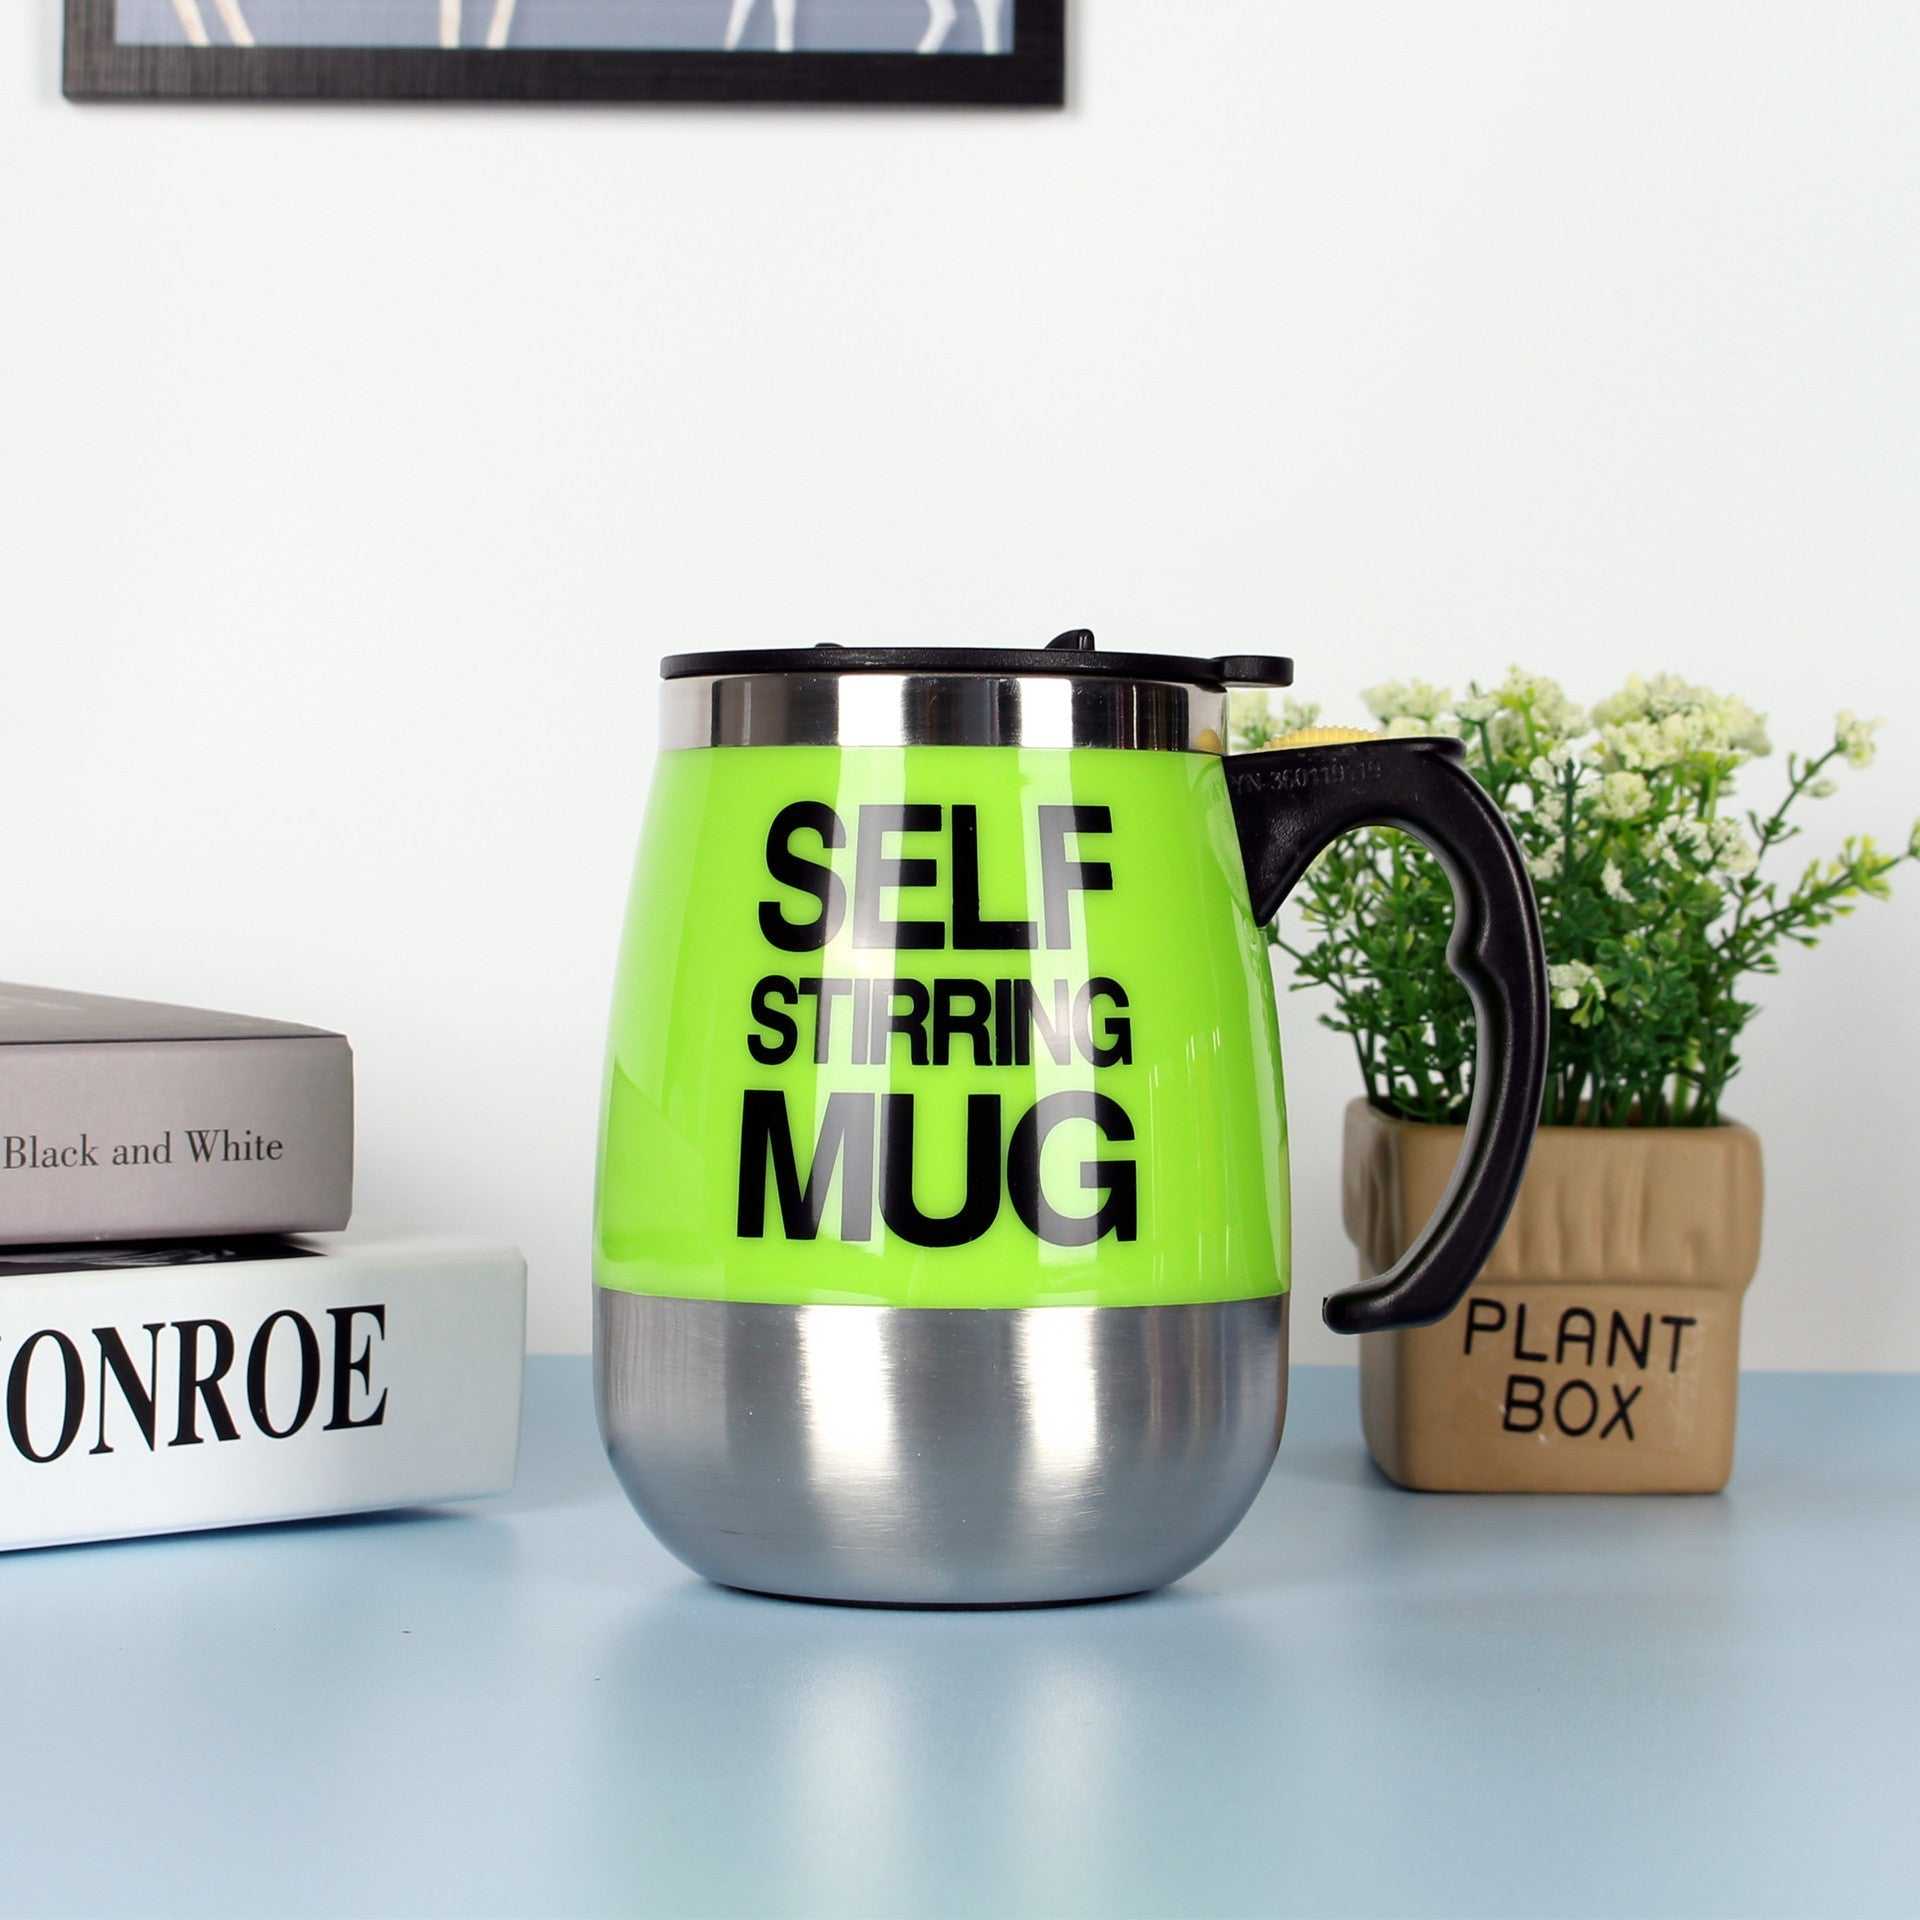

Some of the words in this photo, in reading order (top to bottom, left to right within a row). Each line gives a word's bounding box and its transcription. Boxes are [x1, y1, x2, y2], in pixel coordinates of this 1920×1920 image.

[759, 801, 1113, 952] SELF
[747, 975, 1133, 1068] STIRRING
[3, 1134, 100, 1169] Black
[112, 1131, 172, 1165] and
[185, 1129, 284, 1163] White
[737, 1089, 1138, 1248] MUG
[1463, 1297, 1697, 1373] PLANT
[0, 1303, 389, 1463] ONROE
[1502, 1374, 1643, 1441] BOX
